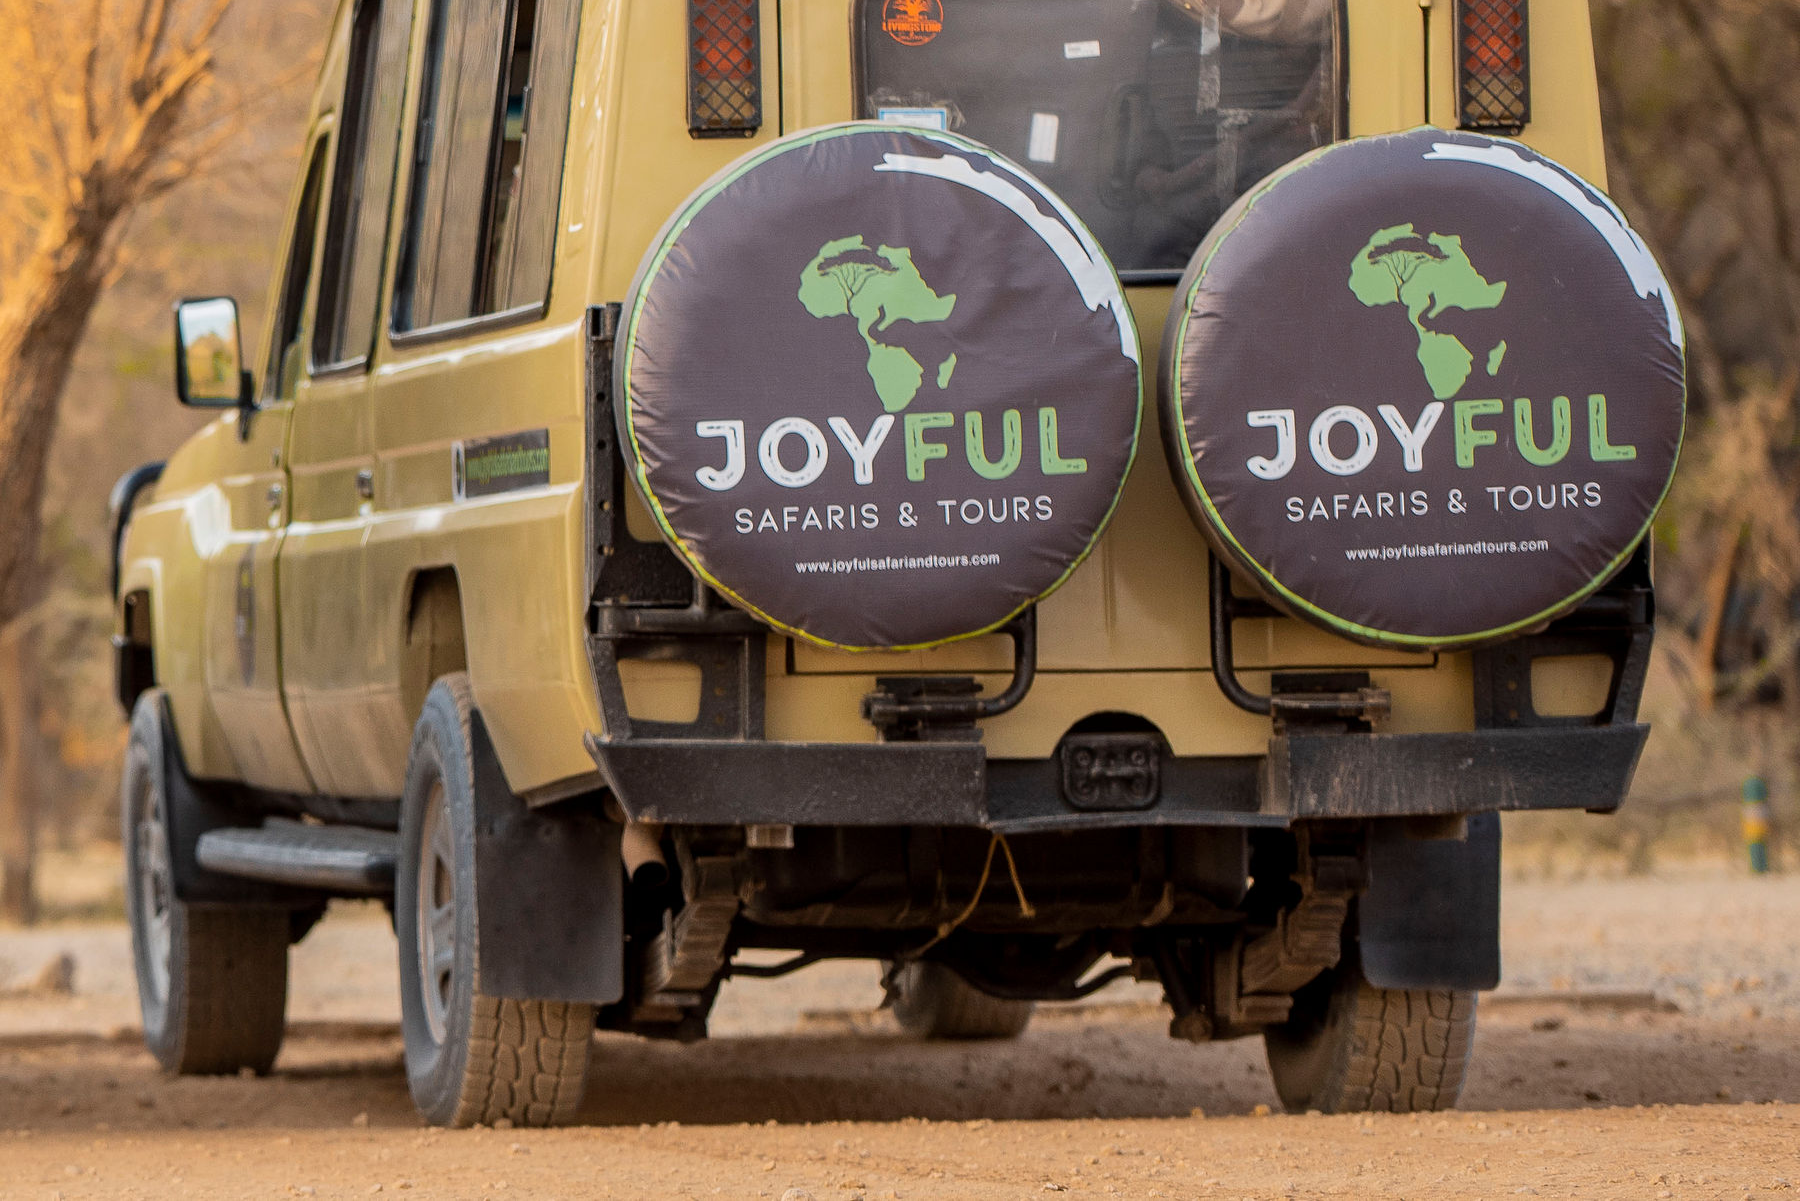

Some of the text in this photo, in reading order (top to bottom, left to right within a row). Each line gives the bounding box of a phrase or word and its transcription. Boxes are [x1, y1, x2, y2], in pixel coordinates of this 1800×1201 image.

[694, 406, 1089, 491] JOYFUL
[1245, 393, 1638, 481] JOYFUL
[734, 495, 1054, 534] SAFARIS & TOURS
[1285, 482, 1603, 522] SAFARIS & TOURS
[795, 553, 1000, 574] www.joyfulsafariandtours.com
[1345, 539, 1549, 561] www.joyfulsafariandtours.com
